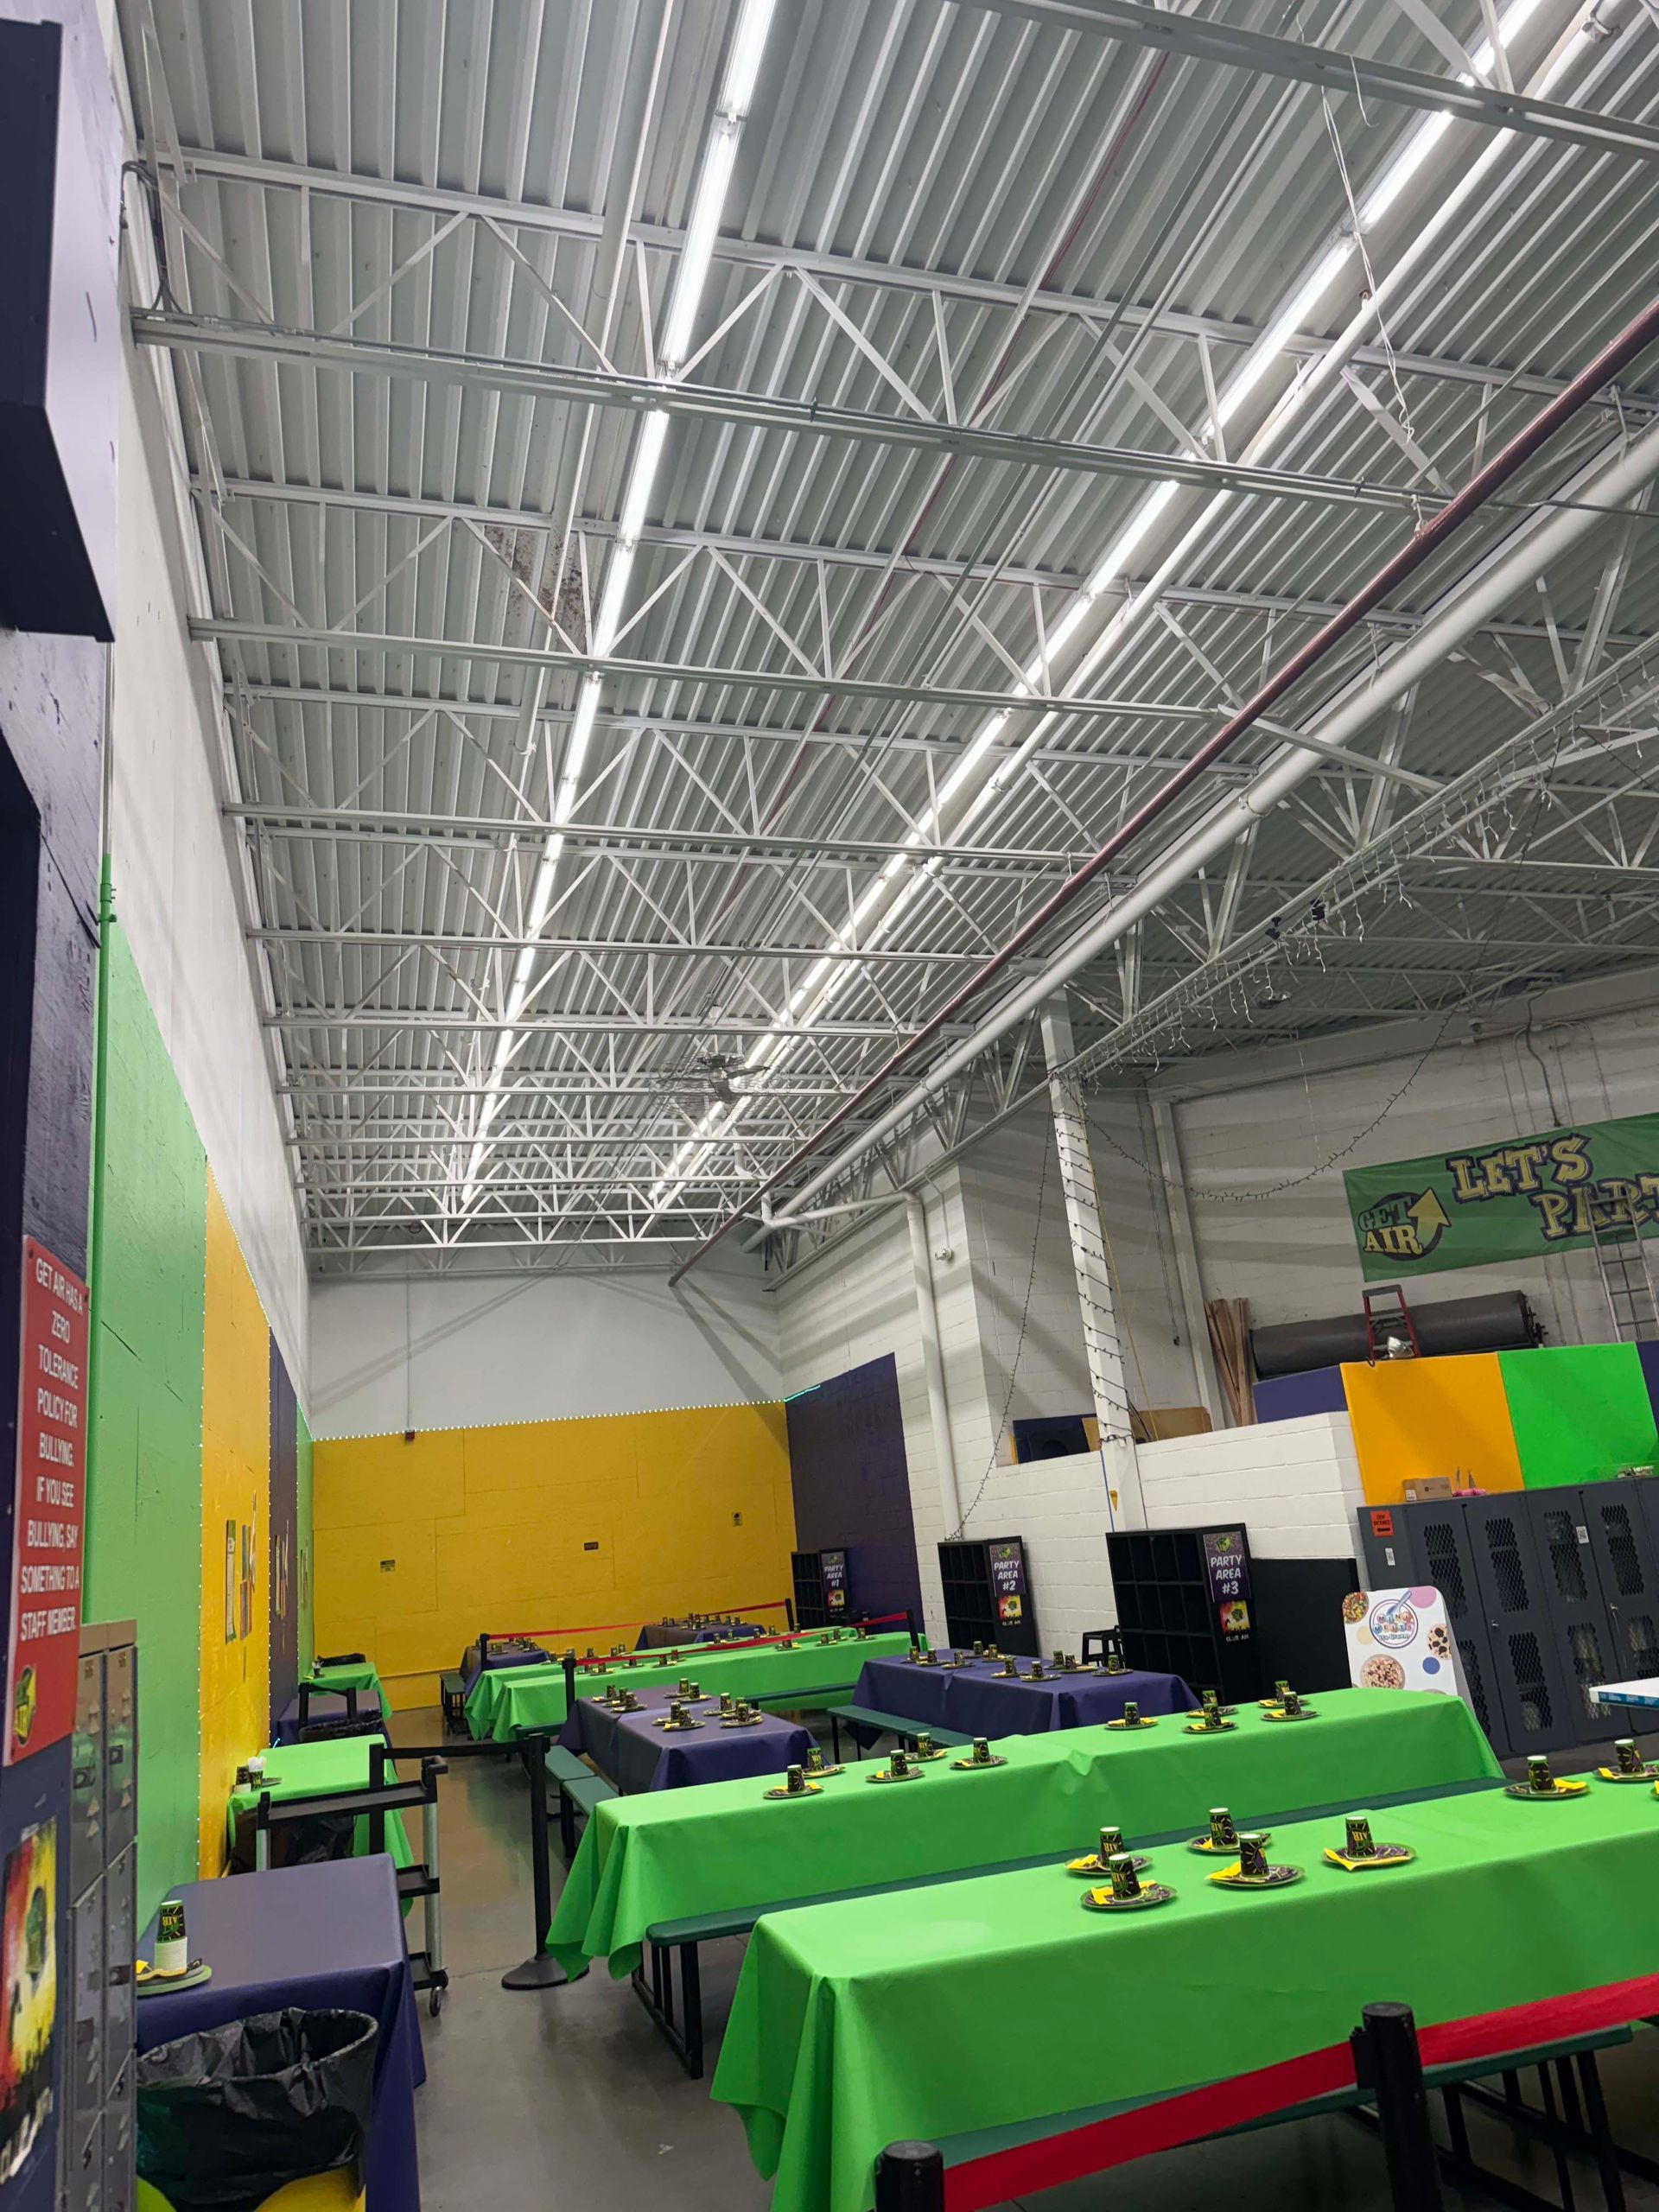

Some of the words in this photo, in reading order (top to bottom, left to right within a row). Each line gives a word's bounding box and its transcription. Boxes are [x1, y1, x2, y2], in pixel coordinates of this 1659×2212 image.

[1446, 1133, 1593, 1204] LET'S
[1358, 1196, 1413, 1232] GET
[1363, 1224, 1423, 1255] AIR
[36, 1257, 53, 1290] GET
[53, 1271, 66, 1300] AIR
[66, 1282, 79, 1313] HAS
[79, 1294, 83, 1315] A
[52, 1310, 70, 1344] ZERO
[37, 1344, 79, 1389] TOLERANCE
[37, 1388, 64, 1422] POLICY
[64, 1401, 78, 1428] FOR
[39, 1432, 74, 1467] BULLYING.
[36, 1476, 45, 1502] IF
[46, 1478, 60, 1505] YOU
[62, 1482, 74, 1507] SEE
[28, 1520, 66, 1553] BULLYING,
[67, 1524, 79, 1548] SAY
[823, 1563, 844, 1573] PARTY
[994, 1560, 1020, 1571] PARTY
[998, 1570, 1019, 1580] AREA
[1211, 1555, 1242, 1567] PARTY
[1216, 1567, 1242, 1580] AREA
[21, 1565, 66, 1594] SOMETHING
[67, 1565, 75, 1590] TO
[74, 1566, 79, 1590] A
[1002, 1580, 1016, 1591] #2
[1222, 1580, 1239, 1595] #3
[21, 1610, 48, 1642] STAFF
